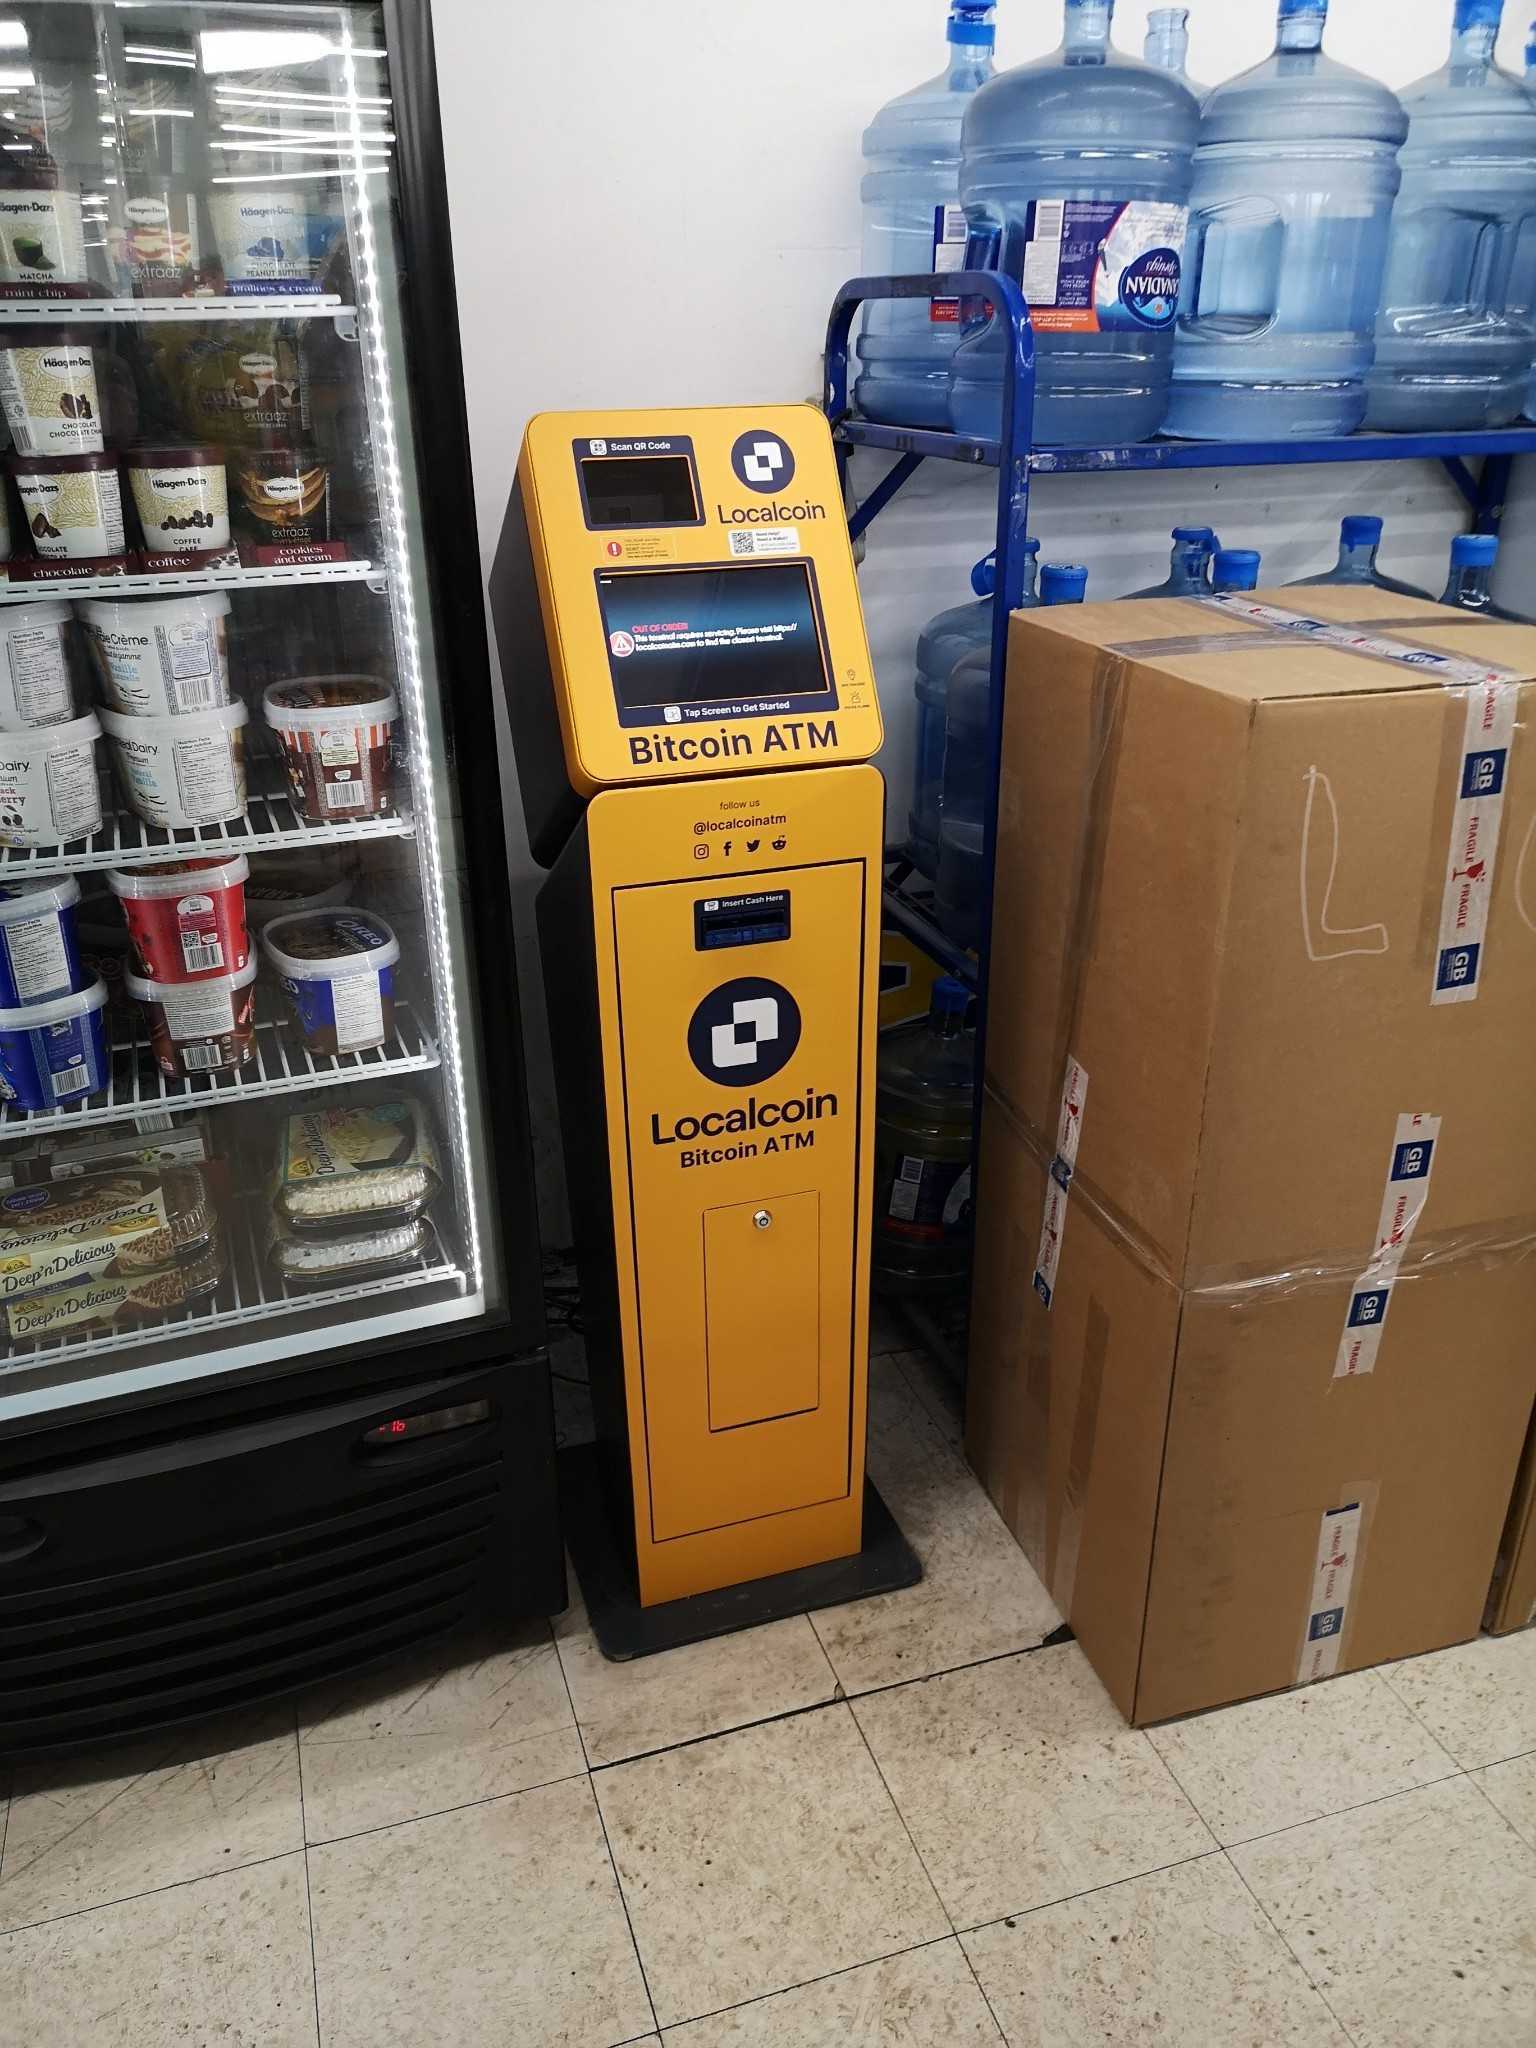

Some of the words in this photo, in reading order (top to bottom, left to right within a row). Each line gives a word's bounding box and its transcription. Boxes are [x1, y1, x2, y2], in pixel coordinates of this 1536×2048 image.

[20, 272, 54, 280] MATCHA
[610, 443, 633, 451] Scan
[633, 442, 647, 451] QR
[647, 441, 671, 450] Code
[18, 483, 59, 495] agen-Dazs
[717, 500, 827, 525] Localcoin
[274, 556, 295, 565] and
[297, 553, 333, 563] cream
[280, 545, 323, 556] cookies
[33, 565, 93, 579] chocolate
[147, 556, 192, 568] coffee
[631, 624, 648, 633] OUT
[649, 624, 660, 632] OF
[735, 626, 760, 636] Please
[695, 639, 705, 647] to
[705, 637, 719, 646] find
[684, 709, 701, 718] Tap
[701, 707, 732, 716] Screen
[732, 705, 741, 714] to
[742, 704, 758, 712] Get
[758, 700, 790, 711] Started
[119, 739, 158, 755] ealDairy
[628, 728, 752, 766] Bitcoin
[763, 720, 838, 752] ATM
[1479, 757, 1496, 791] GB
[720, 801, 748, 811] follow
[749, 799, 761, 808] us
[693, 814, 787, 836] @localcoinatm
[1464, 816, 1480, 864] FRAGILE
[722, 898, 745, 908] Insert
[745, 896, 765, 905] Cash
[765, 894, 784, 902] Here
[1456, 883, 1472, 929] FRAGILE
[336, 920, 382, 945] OREO
[1453, 952, 1470, 981] GB
[651, 1087, 838, 1146] Localcoin
[680, 1136, 758, 1169] Bitcoin
[763, 1129, 815, 1155] ATM
[1406, 1146, 1424, 1175] GB
[2, 1267, 55, 1293] Deep'n
[53, 1242, 117, 1273] Delicious
[14, 1307, 65, 1333] Deep'n
[64, 1285, 127, 1314] Delicious
[1362, 1295, 1379, 1321] GB
[1320, 1613, 1337, 1634] GB
